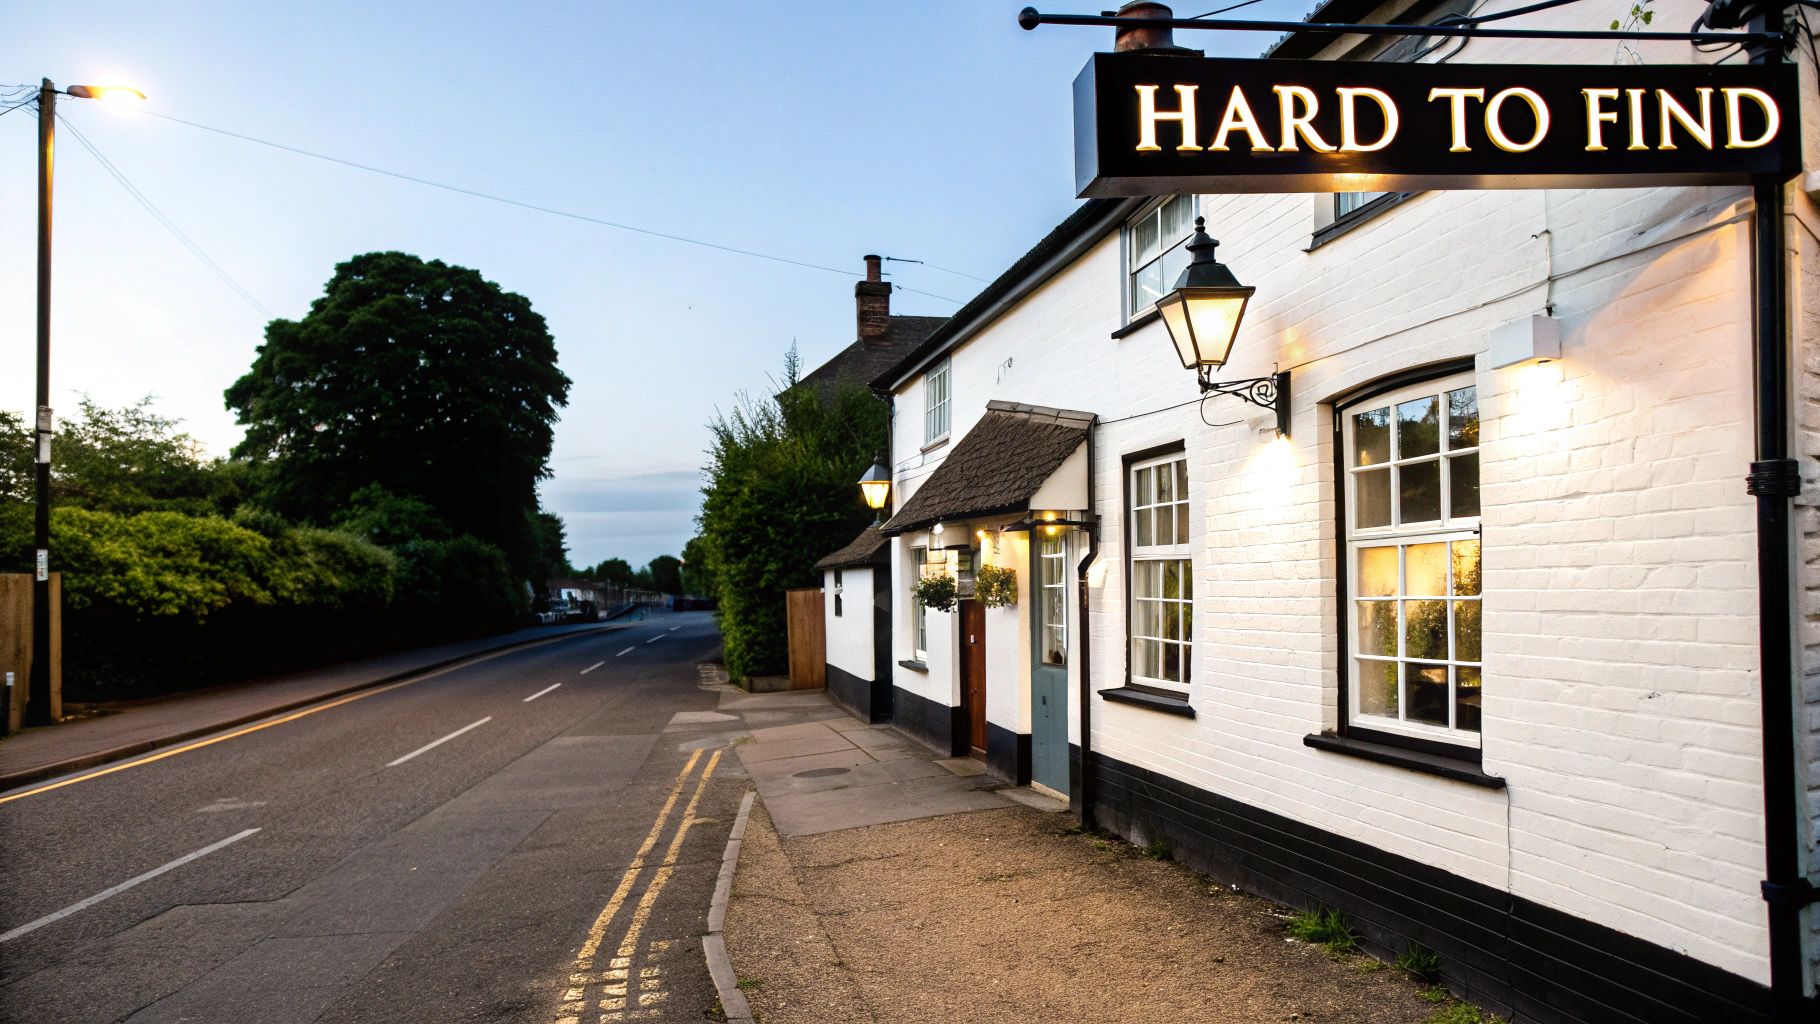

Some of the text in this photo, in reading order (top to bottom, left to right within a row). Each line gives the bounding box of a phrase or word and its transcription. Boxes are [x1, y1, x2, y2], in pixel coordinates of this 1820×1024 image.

[1135, 84, 1781, 153] HARD TO FIND
